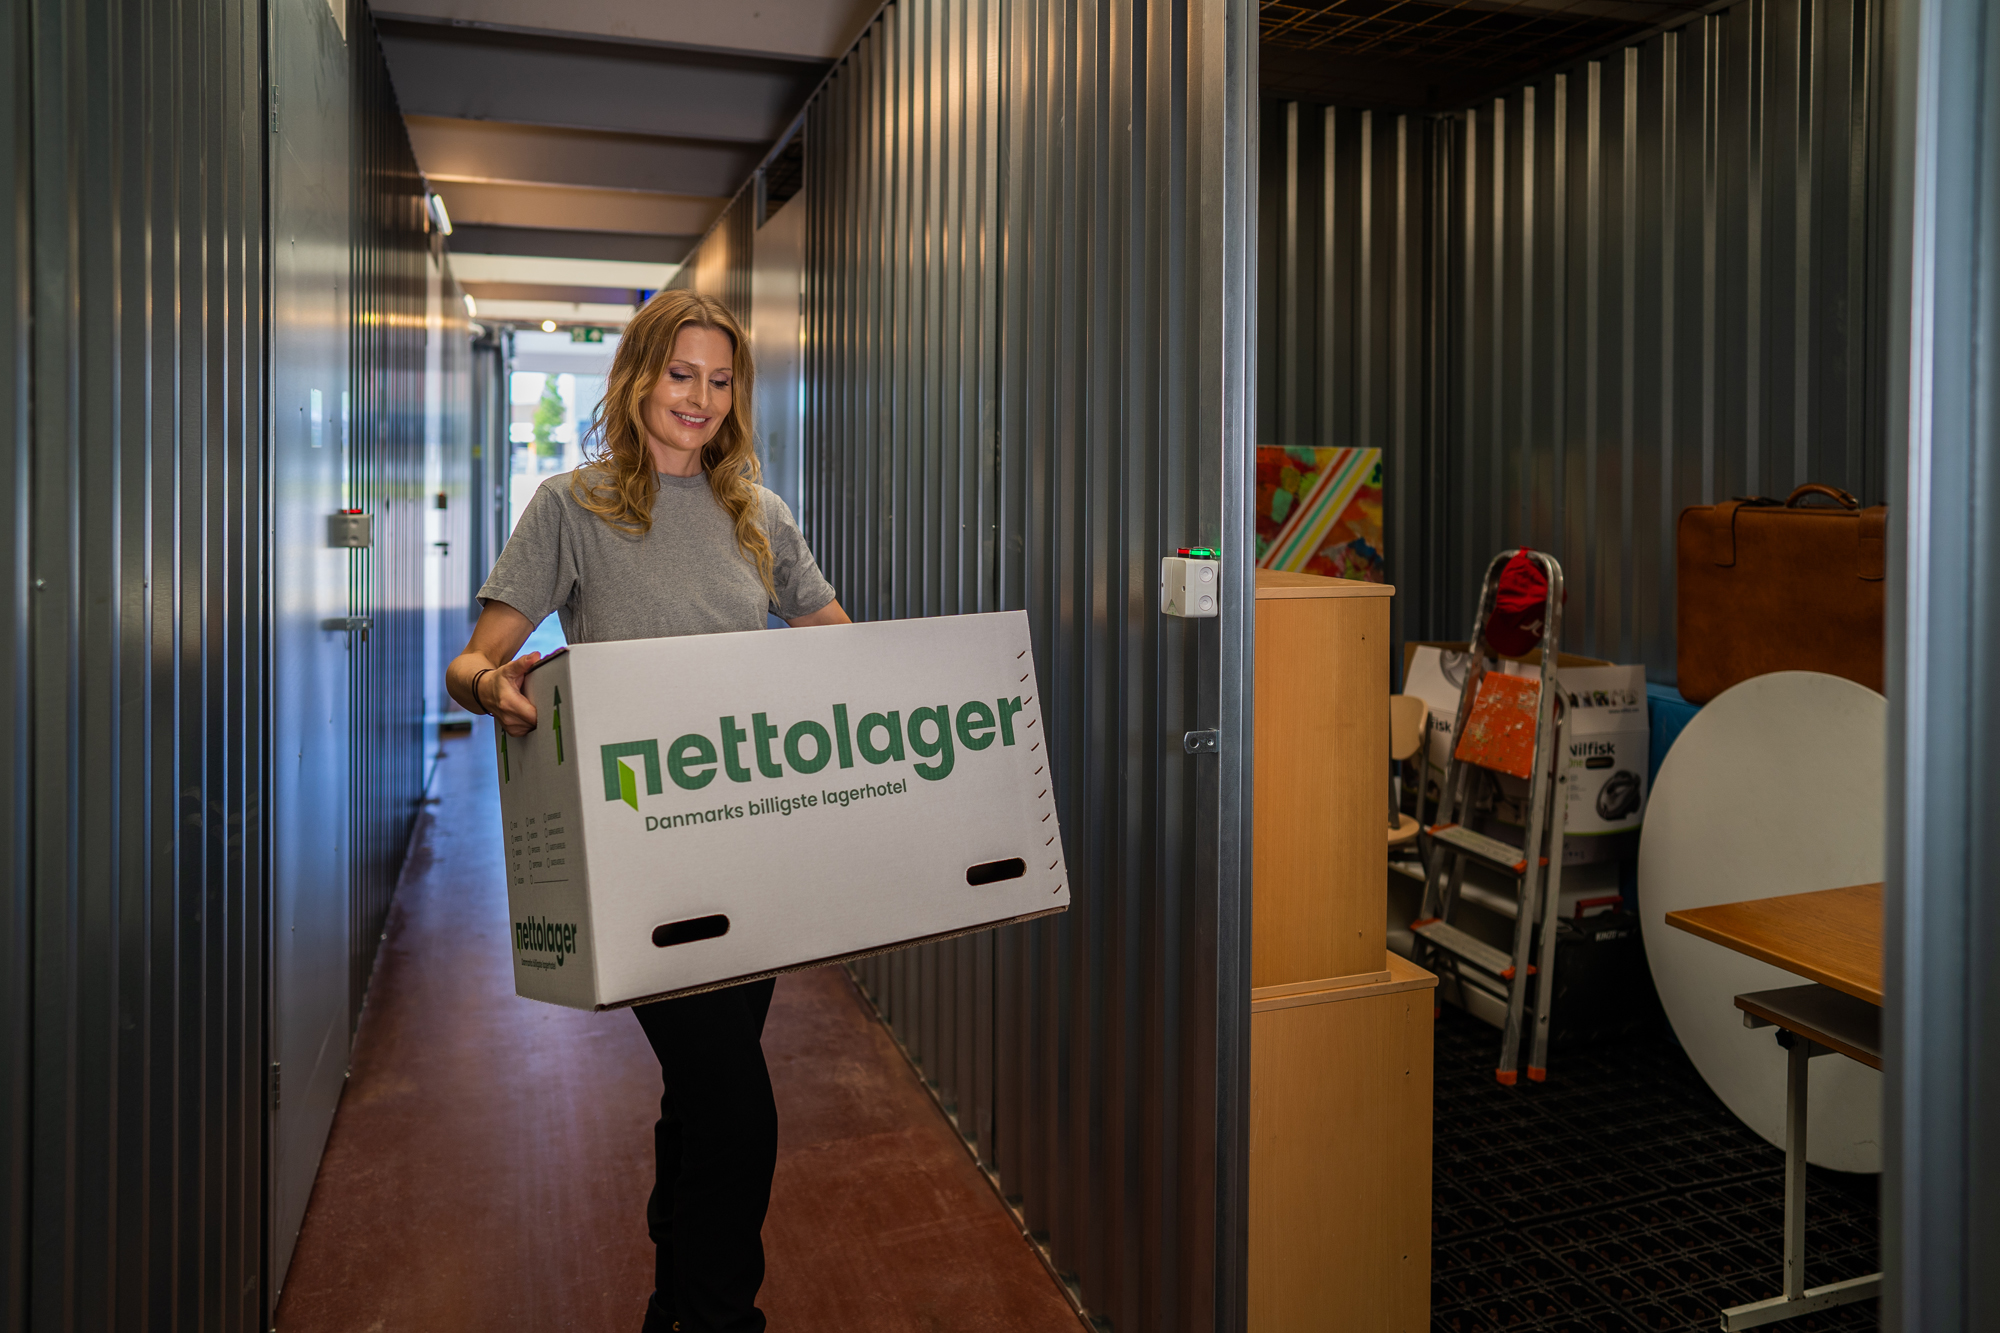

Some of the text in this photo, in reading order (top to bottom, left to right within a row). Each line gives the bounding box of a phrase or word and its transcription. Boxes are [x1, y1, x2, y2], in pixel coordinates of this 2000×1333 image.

[600, 696, 1022, 812] nettolager
[645, 778, 907, 832] Danmarks billigste lagerhotel
[515, 915, 578, 967] nettolager
